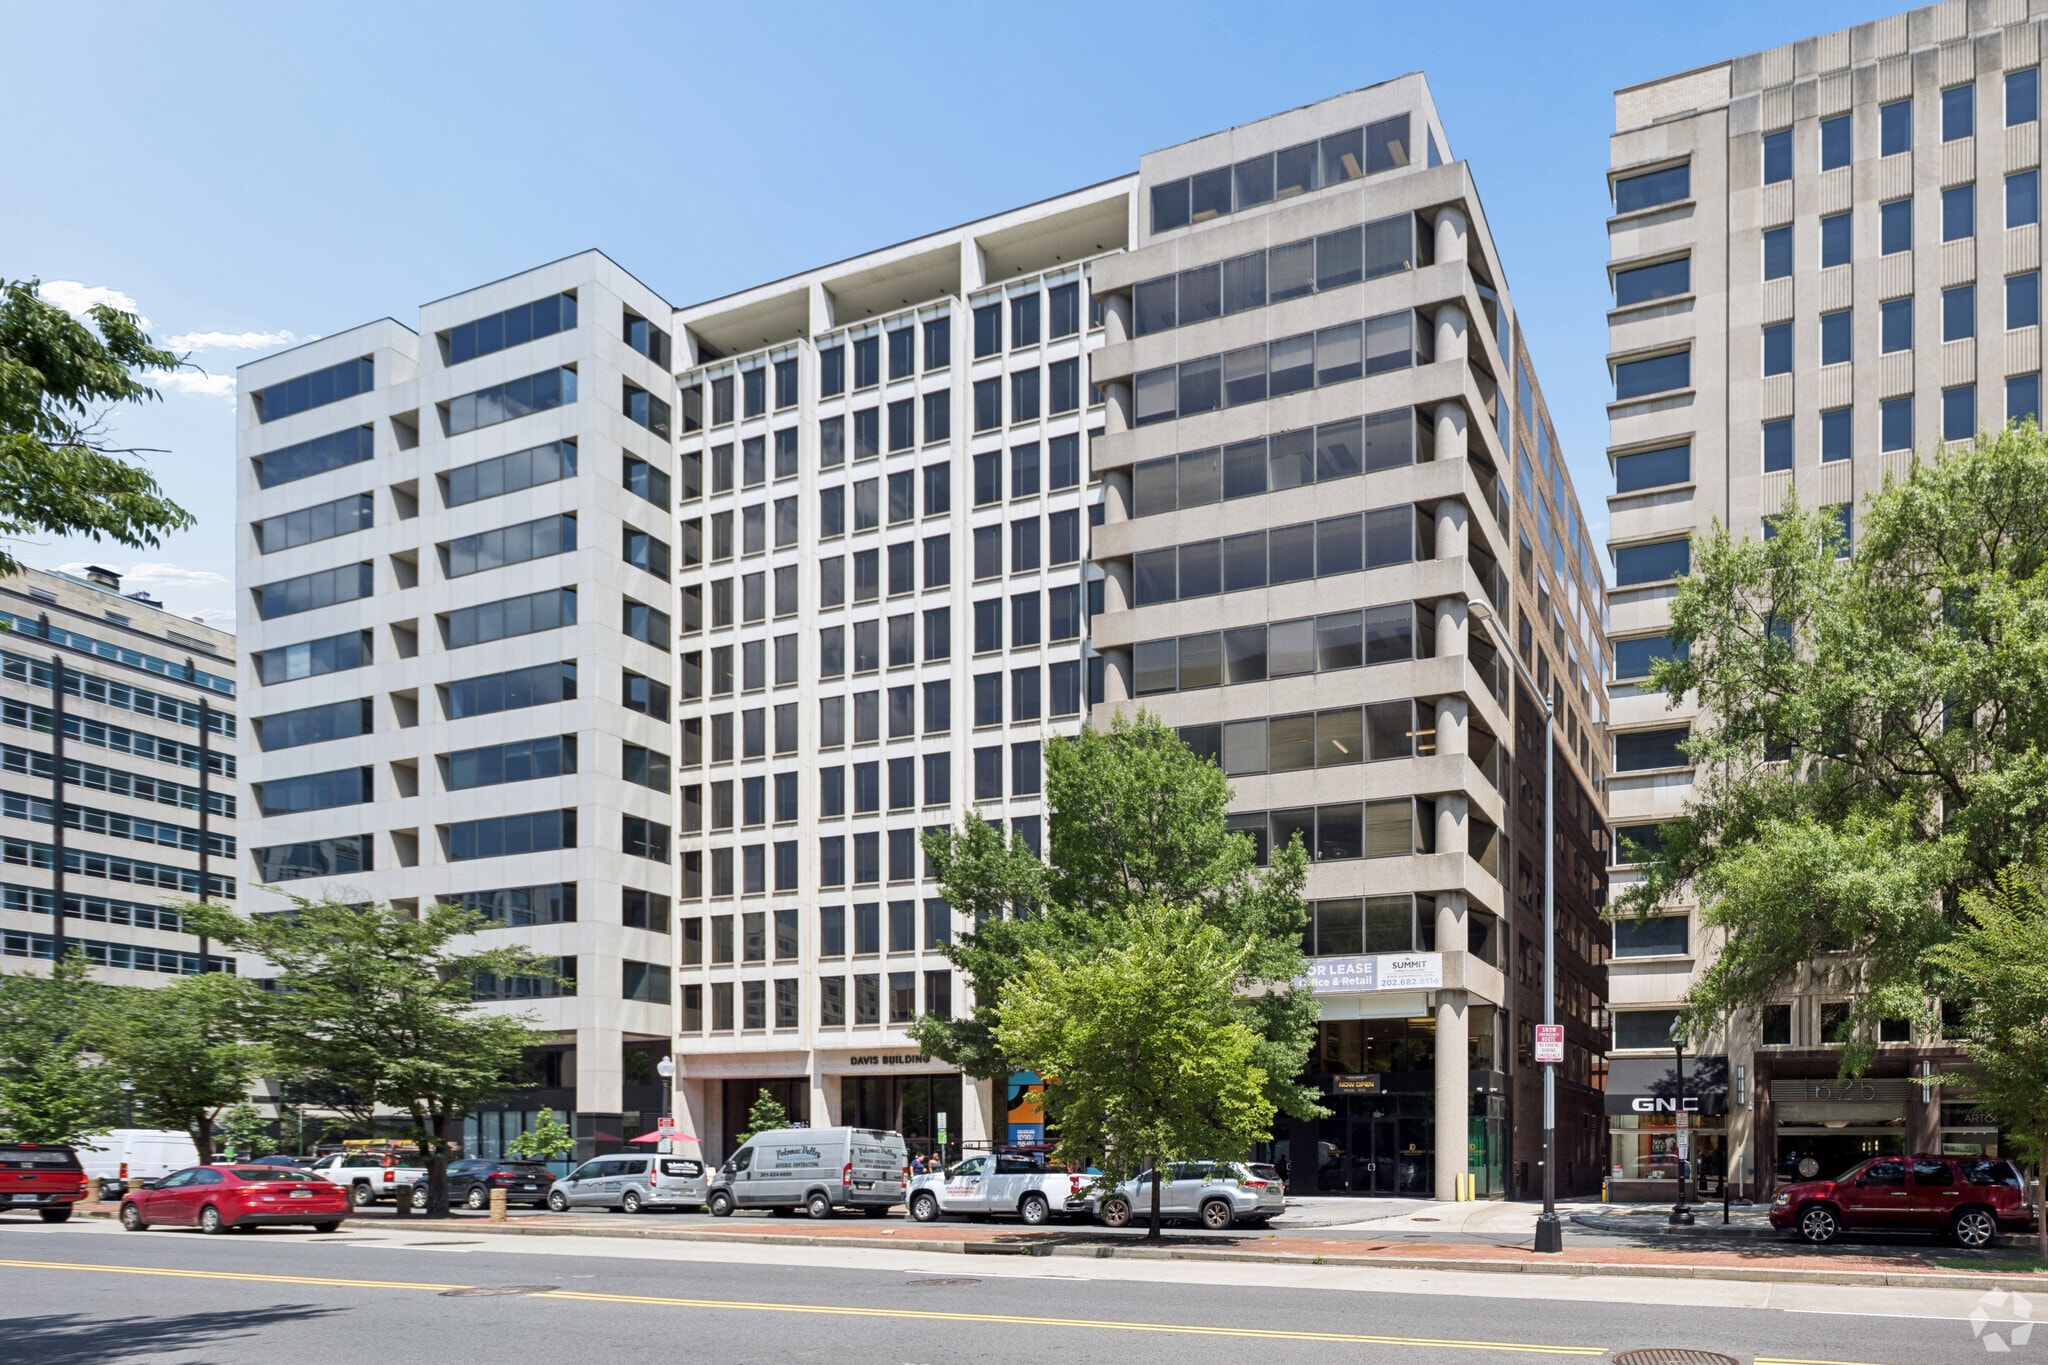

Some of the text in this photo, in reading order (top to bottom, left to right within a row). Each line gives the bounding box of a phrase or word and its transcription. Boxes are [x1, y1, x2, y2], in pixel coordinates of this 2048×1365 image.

[1306, 963, 1372, 976] OR LEASE
[1392, 960, 1427, 969] SUMMIT
[1332, 977, 1340, 986] &
[1341, 976, 1372, 986] Retail
[850, 1056, 879, 1066] DAVIS
[1632, 1098, 1698, 1111] GNC
